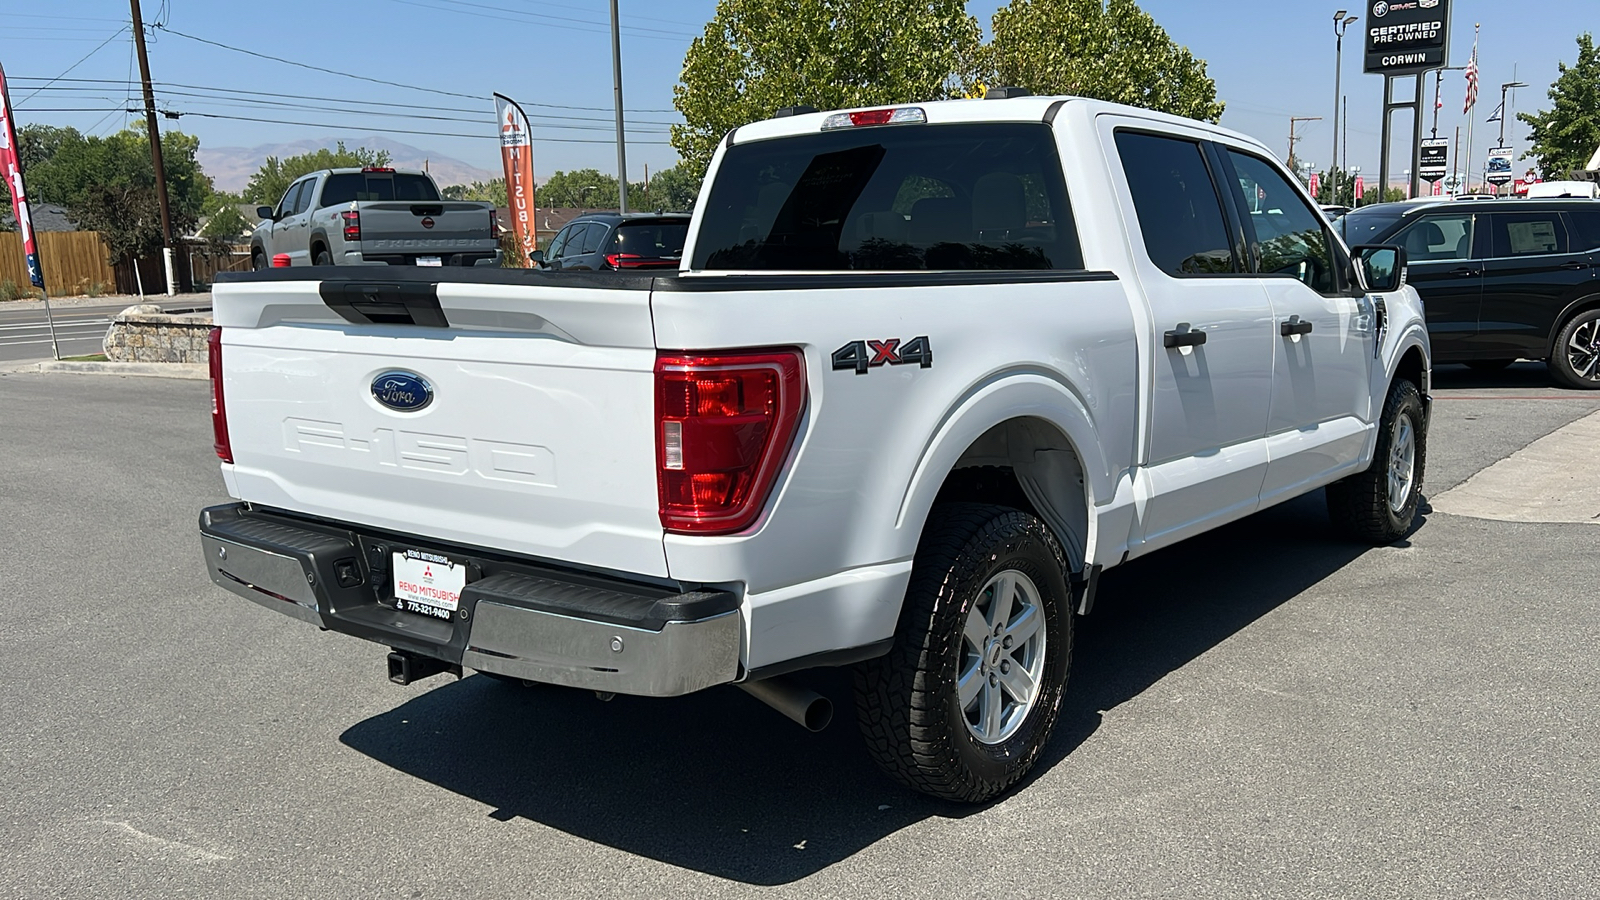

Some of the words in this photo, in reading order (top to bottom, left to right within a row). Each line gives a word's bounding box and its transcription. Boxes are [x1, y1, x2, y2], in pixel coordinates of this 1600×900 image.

[1390, 2, 1417, 11] GMC
[1370, 21, 1441, 36] CERTIFIED
[1373, 30, 1436, 44] PRE-OWNED
[1382, 53, 1426, 66] CORWIN
[374, 239, 480, 248] FRONTIER
[381, 379, 416, 404] Ford
[283, 417, 557, 488] F-150
[407, 549, 420, 559] RENO
[420, 552, 448, 564] MITSUBISHI
[399, 581, 418, 594] RENO
[419, 585, 459, 602] MITSUBISH
[407, 601, 450, 619] 775-321-9400
